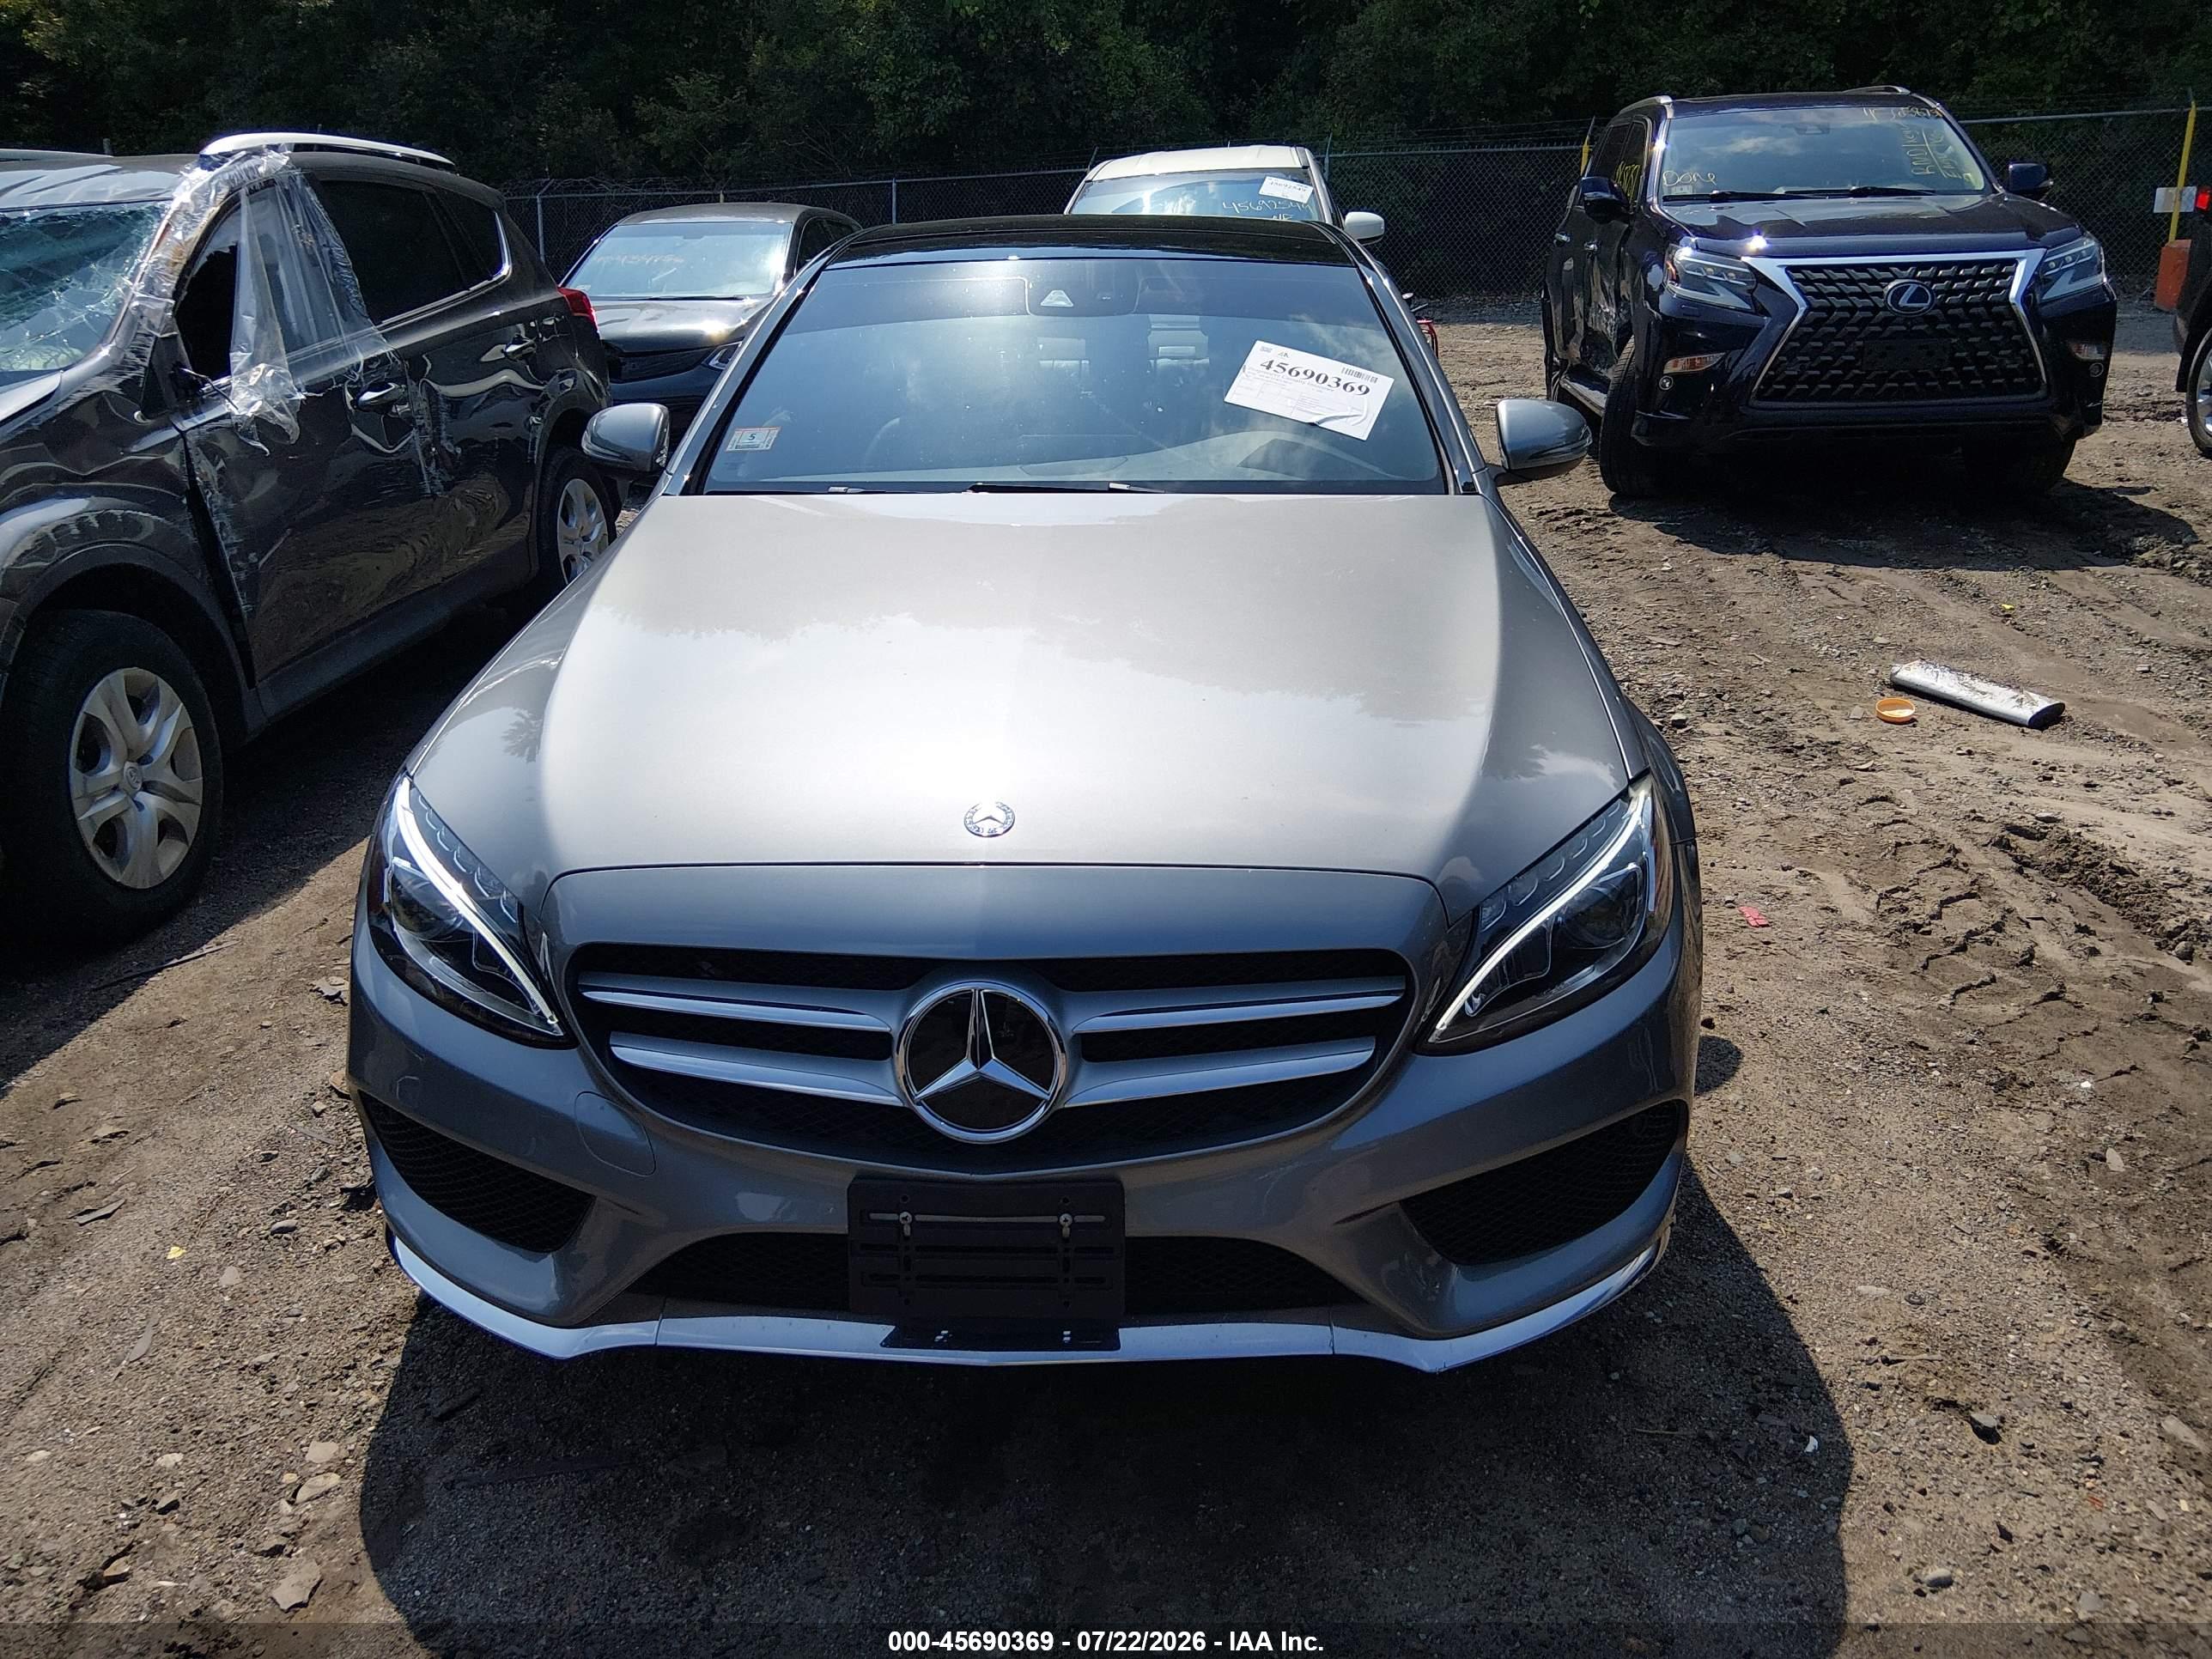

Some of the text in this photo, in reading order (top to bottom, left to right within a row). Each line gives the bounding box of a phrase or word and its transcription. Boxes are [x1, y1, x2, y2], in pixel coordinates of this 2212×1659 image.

[1662, 171, 1717, 186] Done
[1260, 359, 1370, 396] 45690369
[748, 433, 757, 441] 5
